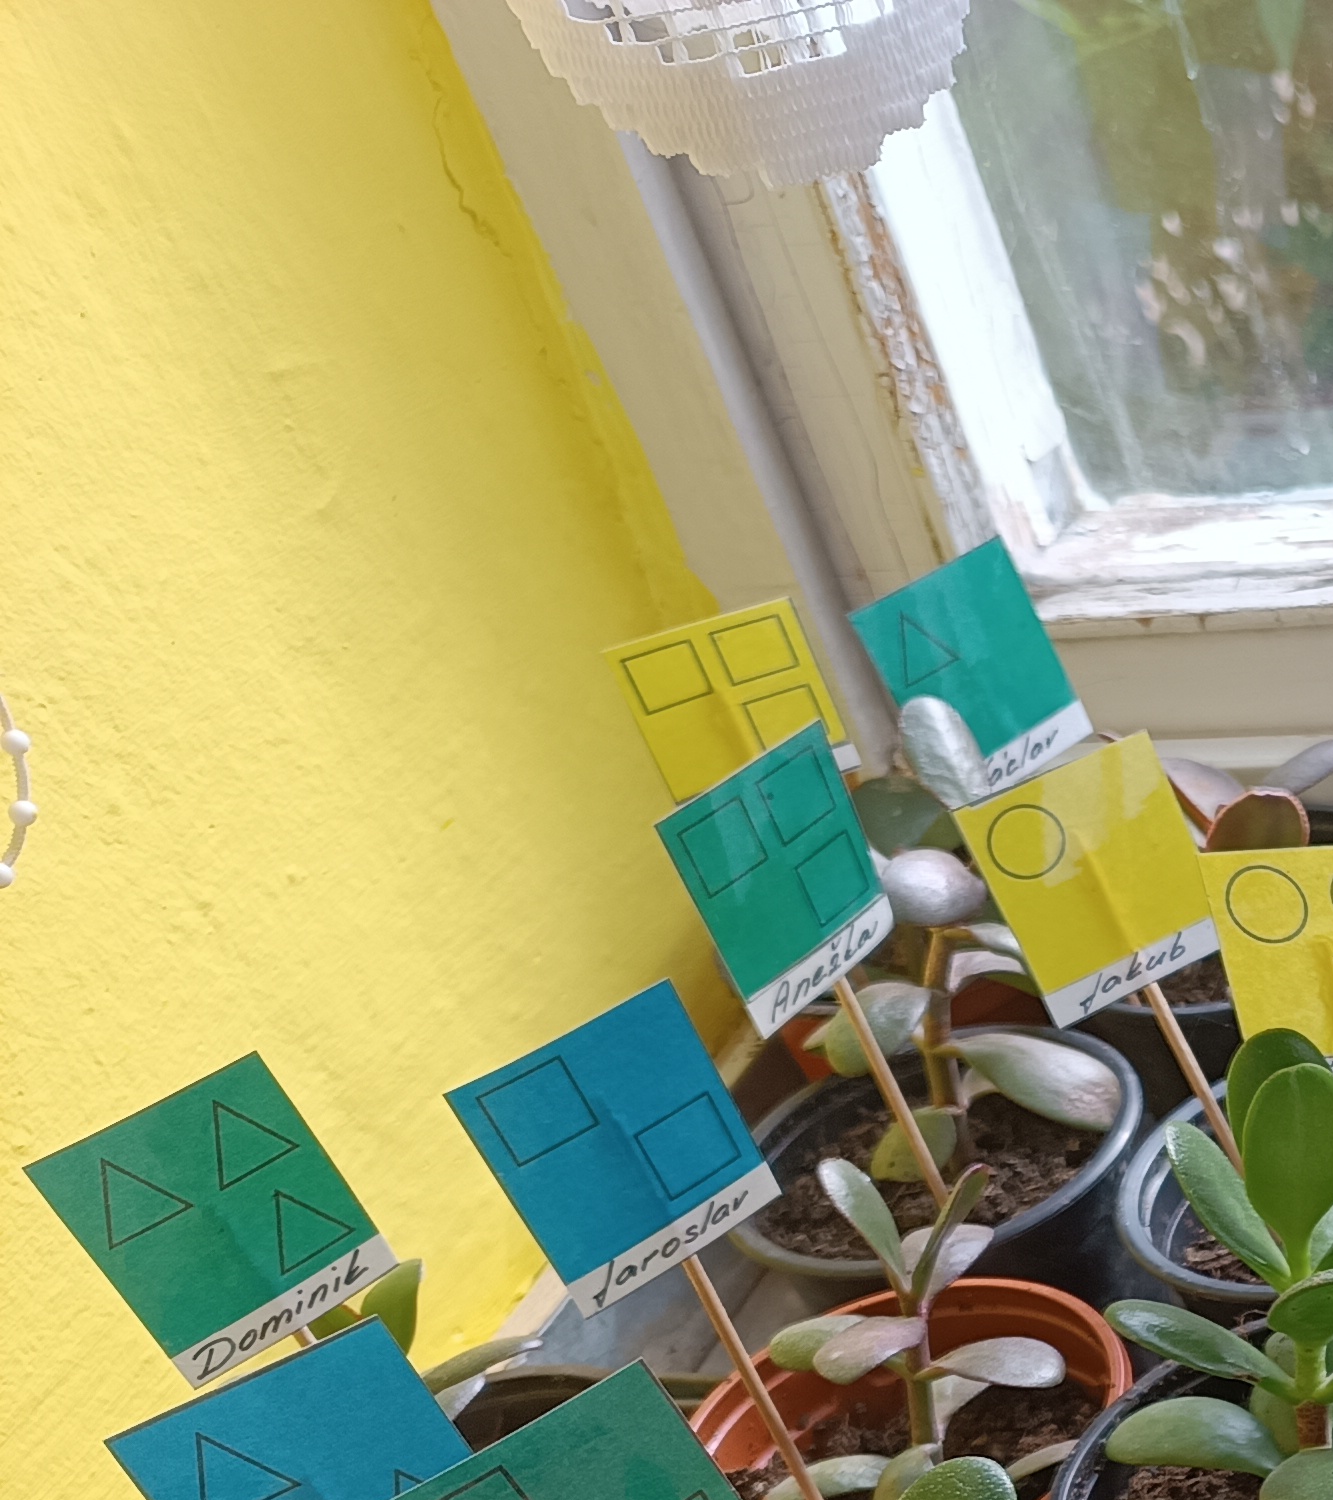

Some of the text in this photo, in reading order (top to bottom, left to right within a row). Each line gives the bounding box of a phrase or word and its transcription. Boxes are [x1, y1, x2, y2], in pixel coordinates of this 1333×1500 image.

[986, 729, 1060, 788] áclav
[771, 920, 880, 1023] Anežka
[1079, 939, 1188, 1014] Jakub
[592, 1189, 749, 1310] Jaroslav
[191, 1247, 370, 1381] Dominik
